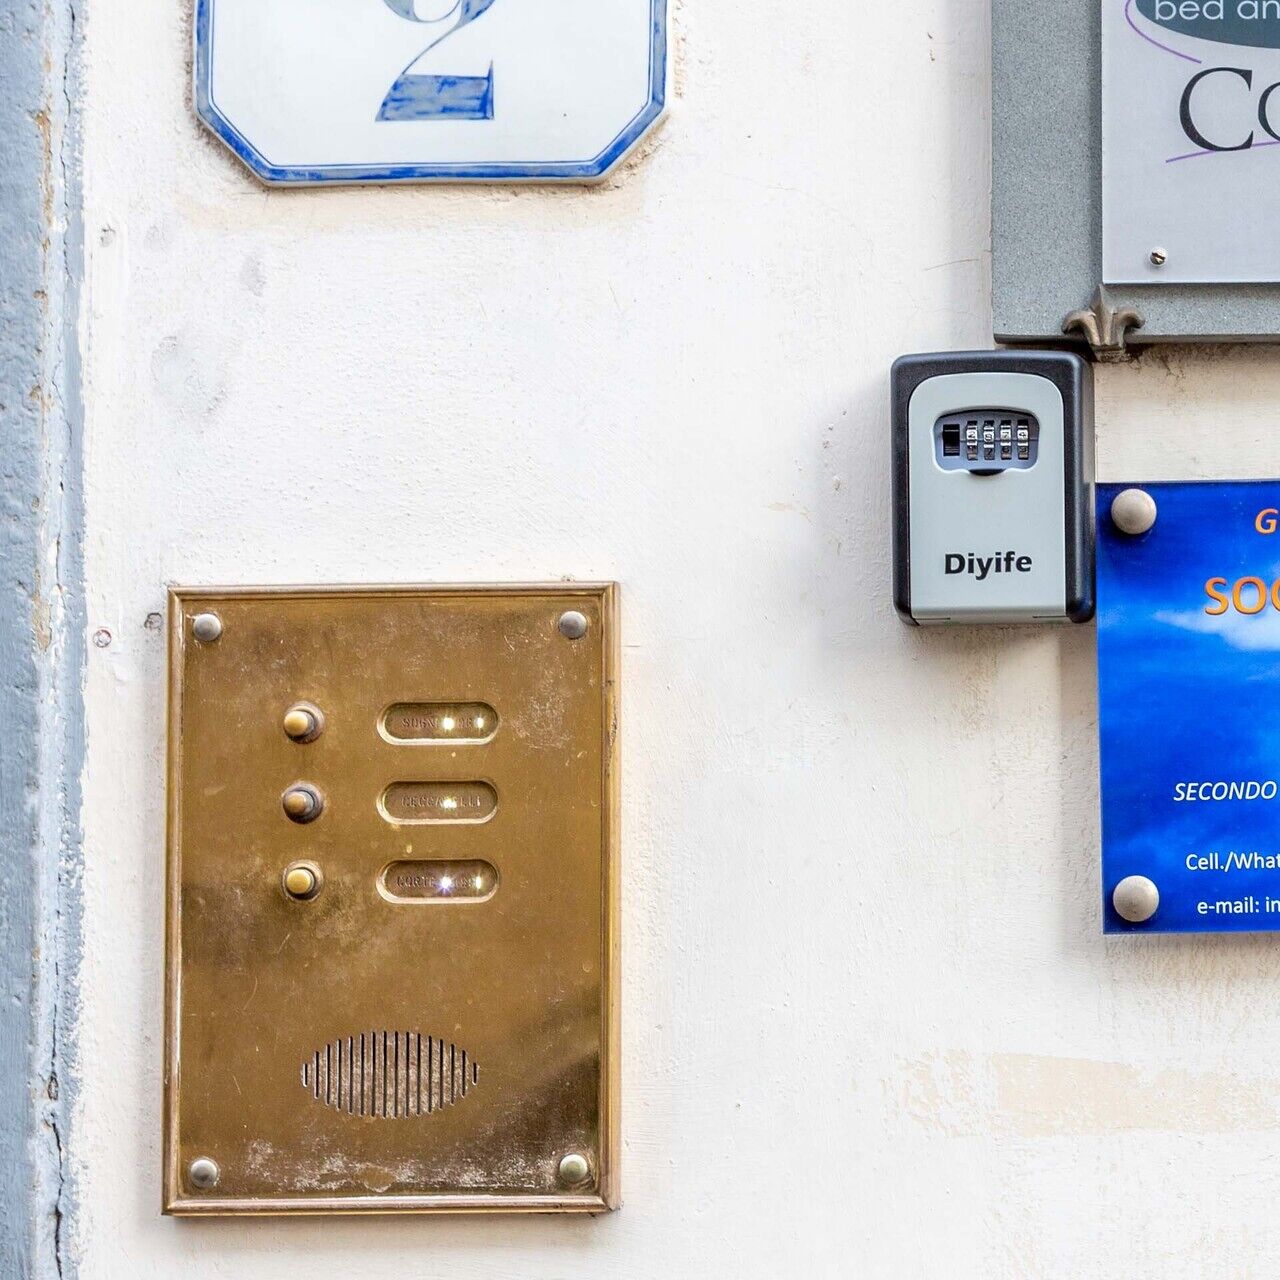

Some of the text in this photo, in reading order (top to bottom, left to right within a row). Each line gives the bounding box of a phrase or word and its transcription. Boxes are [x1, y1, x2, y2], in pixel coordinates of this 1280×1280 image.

[944, 551, 1033, 580] Diyife
[1173, 780, 1277, 801] SECONDO
[1197, 896, 1261, 914] e-mail:
